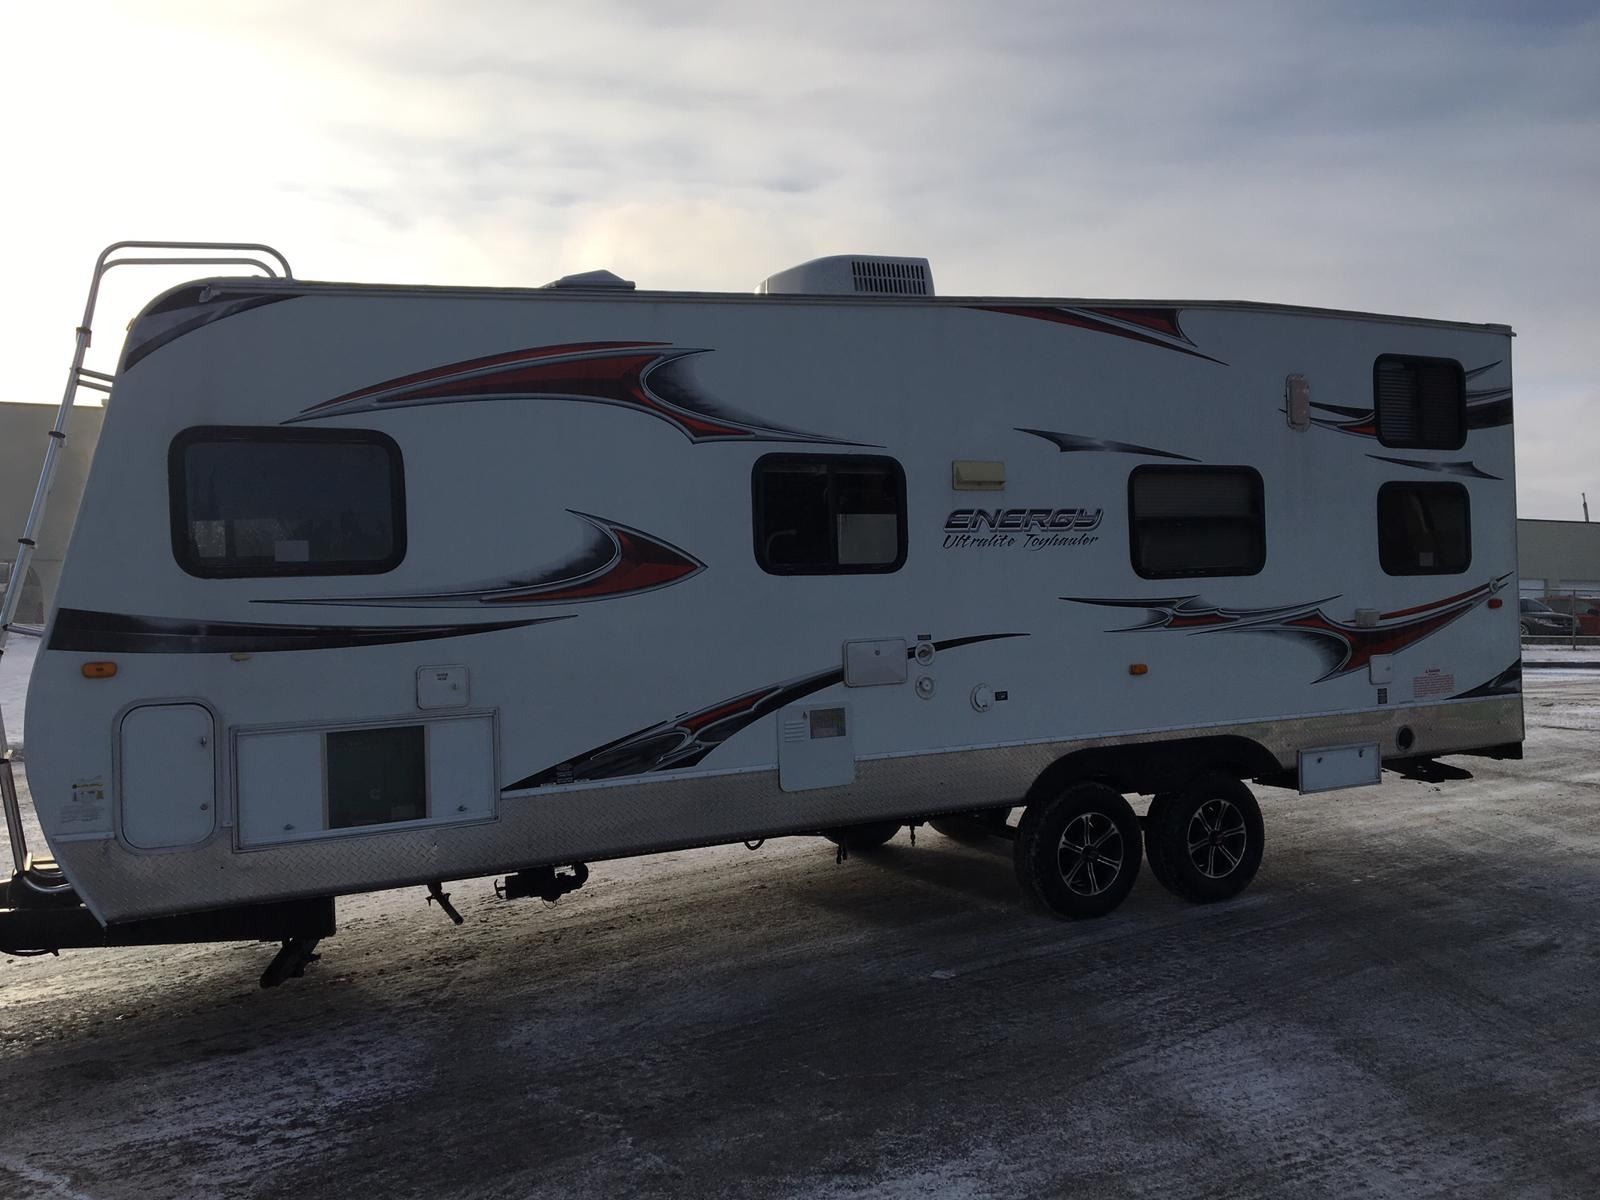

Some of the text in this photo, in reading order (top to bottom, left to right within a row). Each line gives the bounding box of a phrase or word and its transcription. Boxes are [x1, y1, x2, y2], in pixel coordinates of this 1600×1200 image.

[944, 508, 1104, 532] ENERGY
[942, 533, 1099, 551] Ultralite Toyhauler
